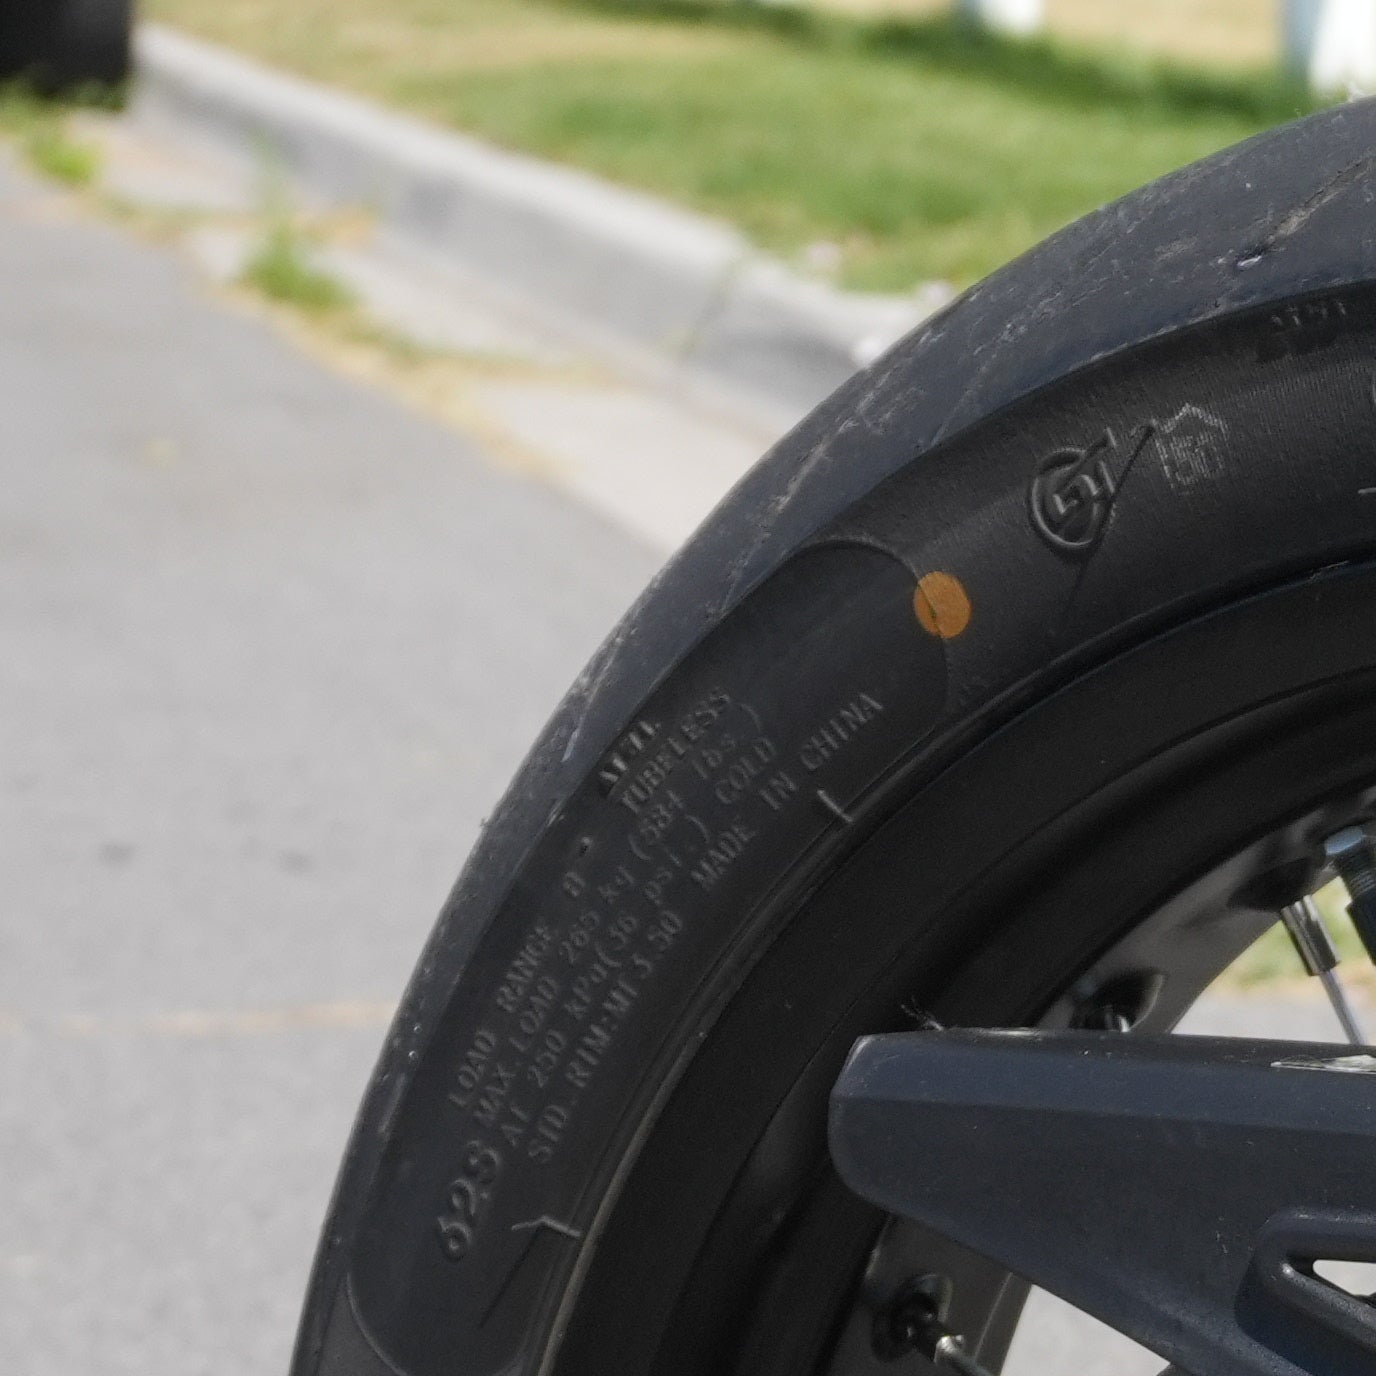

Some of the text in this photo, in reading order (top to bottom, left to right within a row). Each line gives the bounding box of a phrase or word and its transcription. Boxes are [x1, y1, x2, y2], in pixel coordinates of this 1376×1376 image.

[619, 683, 732, 815] TUBELESS
[687, 692, 882, 891] MADE IN CHINA
[493, 919, 560, 1013] RANGE
[523, 1026, 570, 1090] 250
[710, 734, 779, 805] COLD
